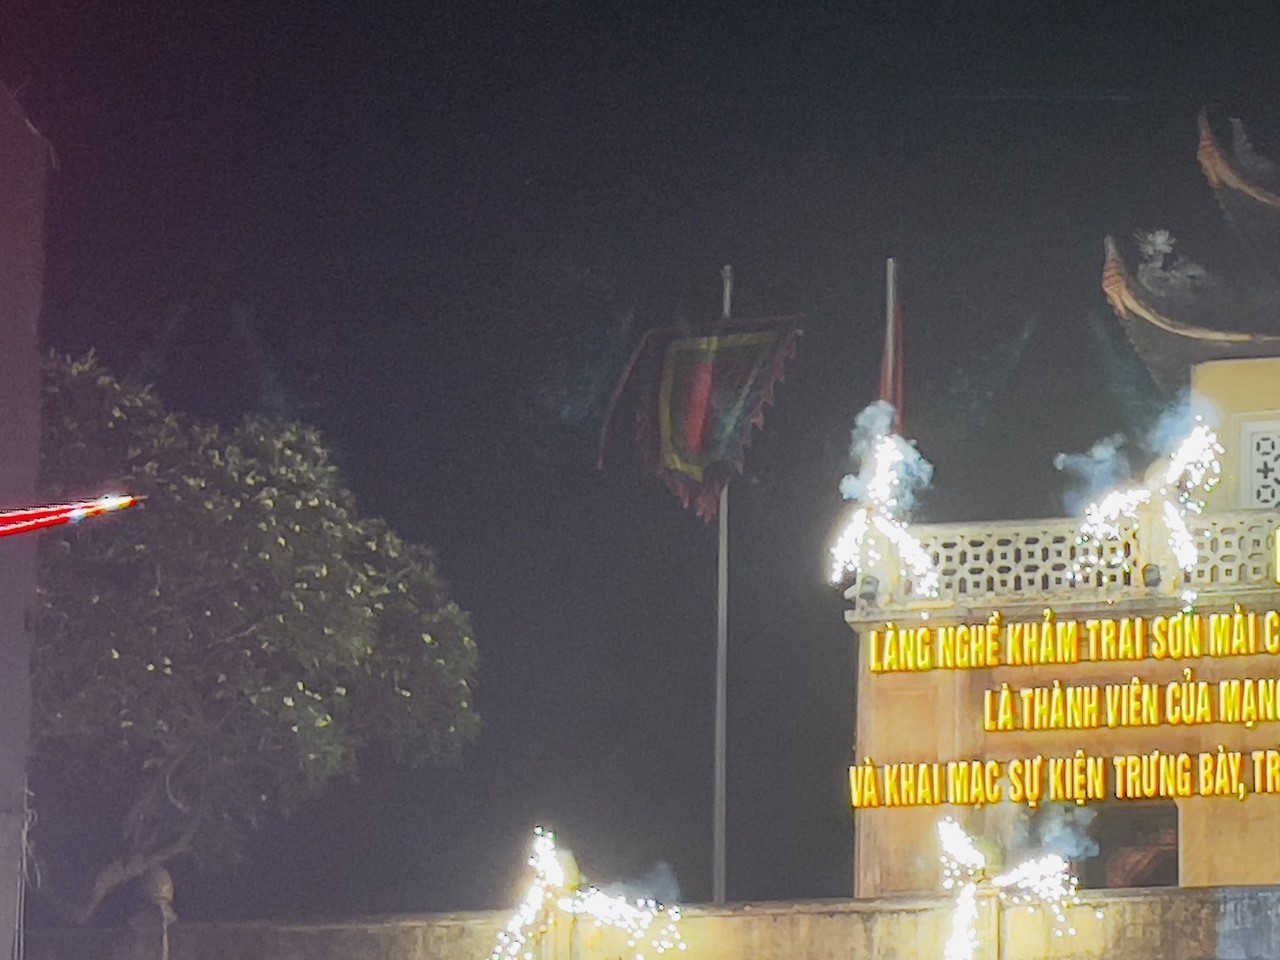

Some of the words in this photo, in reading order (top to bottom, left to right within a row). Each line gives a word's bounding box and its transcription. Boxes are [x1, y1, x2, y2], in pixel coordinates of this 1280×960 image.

[870, 621, 931, 672] LÀNG
[937, 610, 1002, 669] NGHỀ
[1007, 607, 1079, 666] KHẢM
[1086, 616, 1145, 661] TRAI
[1152, 611, 1201, 659] SƠN
[1209, 603, 1256, 656] MÀI
[983, 682, 1015, 731] LÀ
[1020, 680, 1099, 730] THÀNH
[1105, 676, 1159, 728] VIÊN
[1166, 667, 1211, 725] CỦA
[849, 756, 878, 808] VÀ
[884, 763, 941, 807] KHAI
[947, 759, 1001, 810] MẠC
[1008, 755, 1043, 808] SỰ
[1049, 749, 1106, 807] KIỆN
[1113, 750, 1191, 799] TRƯNG
[1199, 744, 1246, 801] BÀY,
